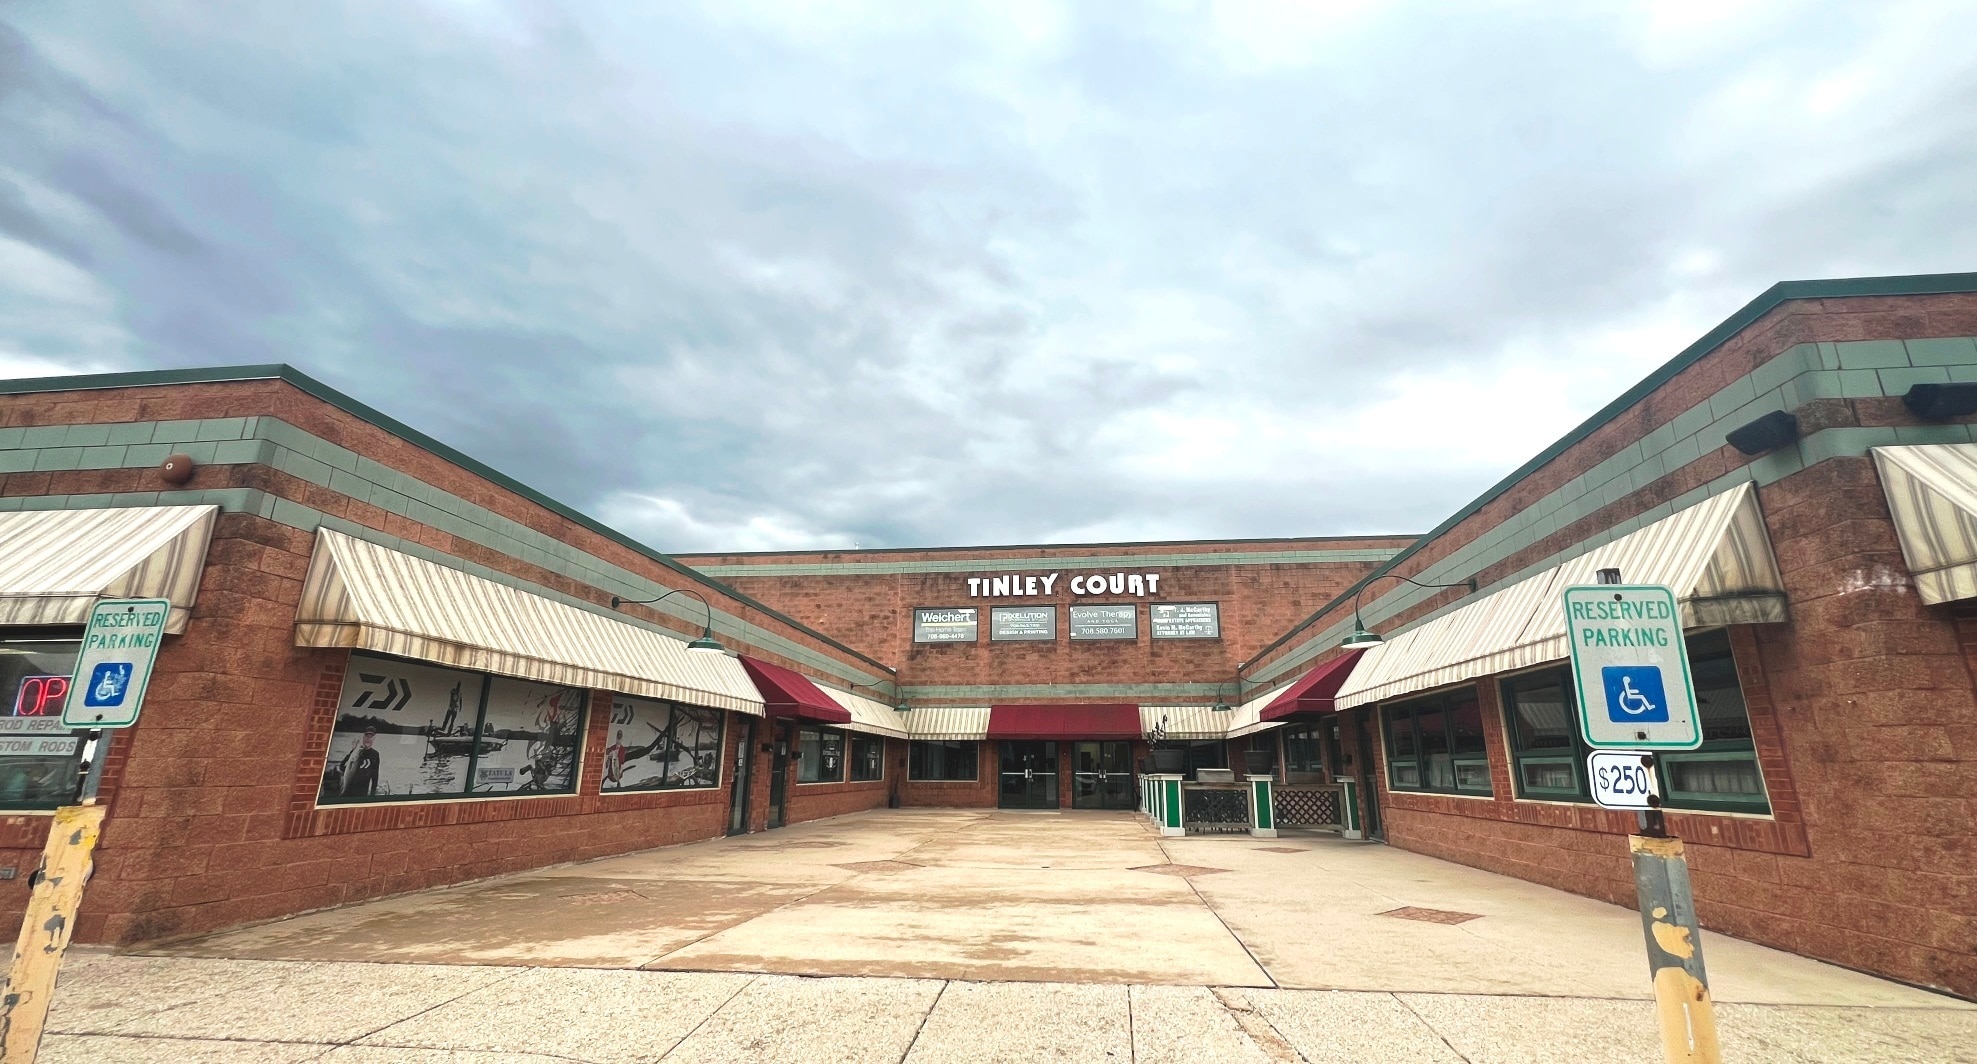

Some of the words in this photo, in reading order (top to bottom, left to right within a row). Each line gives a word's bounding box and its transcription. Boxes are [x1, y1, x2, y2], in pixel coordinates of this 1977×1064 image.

[968, 573, 1059, 597] TINLEY
[1070, 573, 1160, 596] COURT
[921, 612, 971, 623] Weichert
[1100, 610, 1132, 619] Therapy
[1572, 601, 1670, 620] RESERVED
[93, 611, 161, 628] RESERVED
[89, 633, 154, 649] PARKING
[1583, 627, 1668, 647] PARKING
[19, 678, 66, 716] OP
[27, 720, 66, 731] REPA
[0, 741, 32, 752] STOM
[38, 741, 76, 752] RODS
